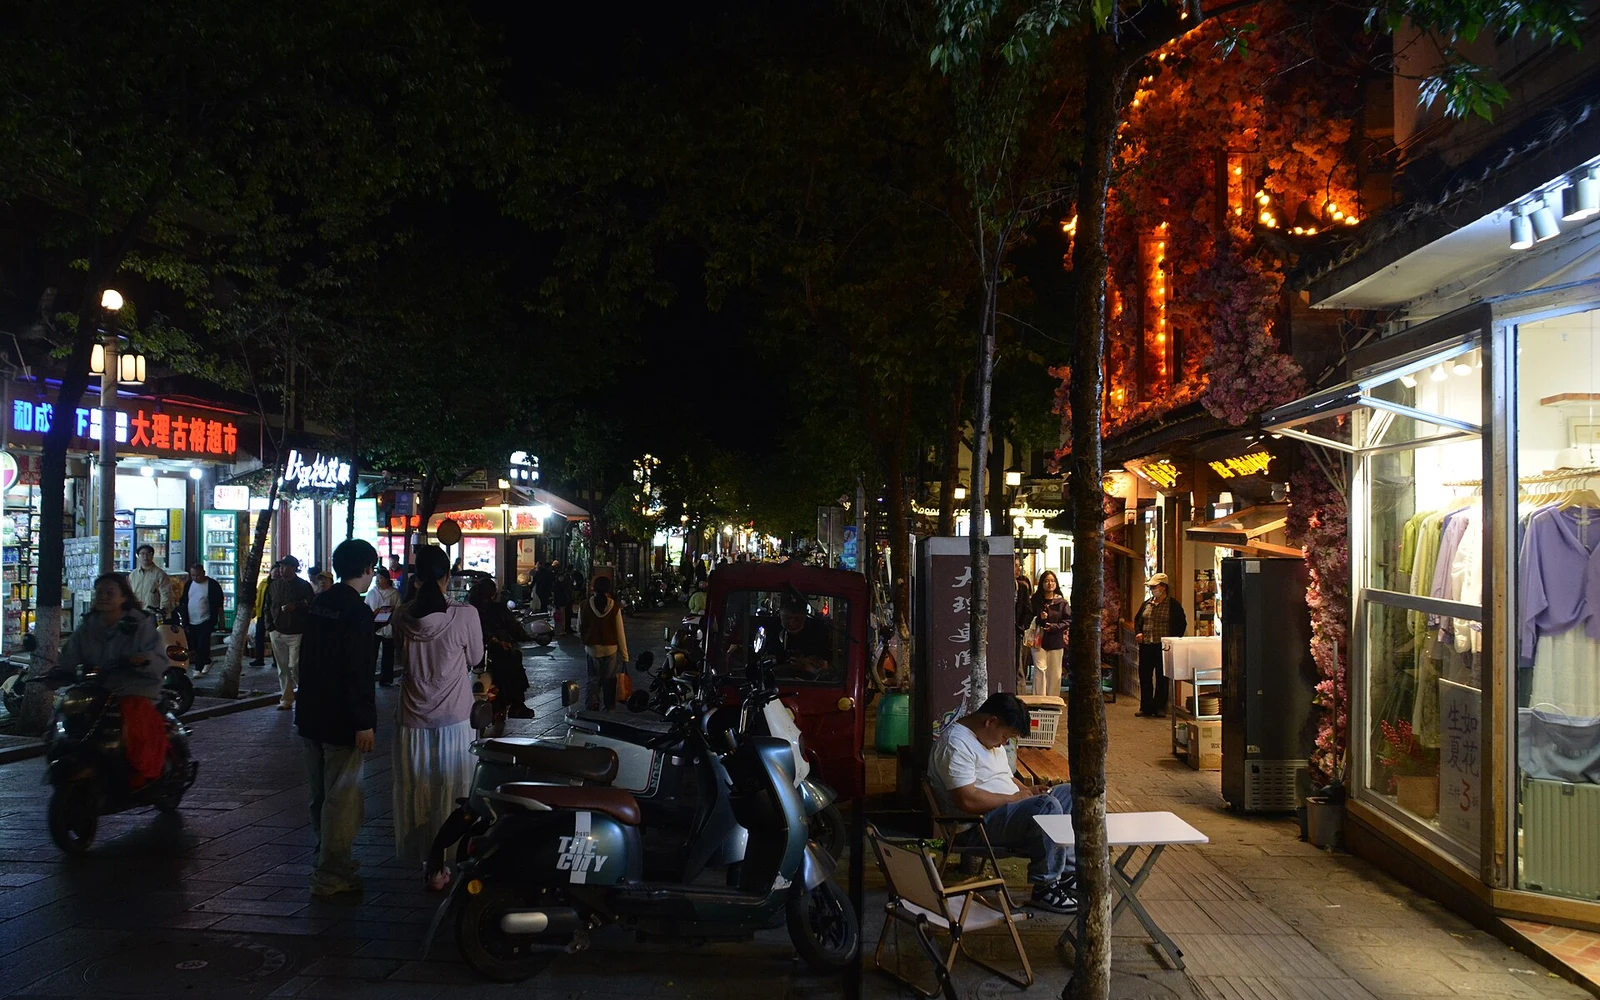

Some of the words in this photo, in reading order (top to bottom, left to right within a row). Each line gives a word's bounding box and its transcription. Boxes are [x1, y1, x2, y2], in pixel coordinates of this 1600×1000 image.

[130, 409, 238, 456] 大理古榕超市
[557, 836, 599, 856] THE
[556, 853, 609, 873] CITY
